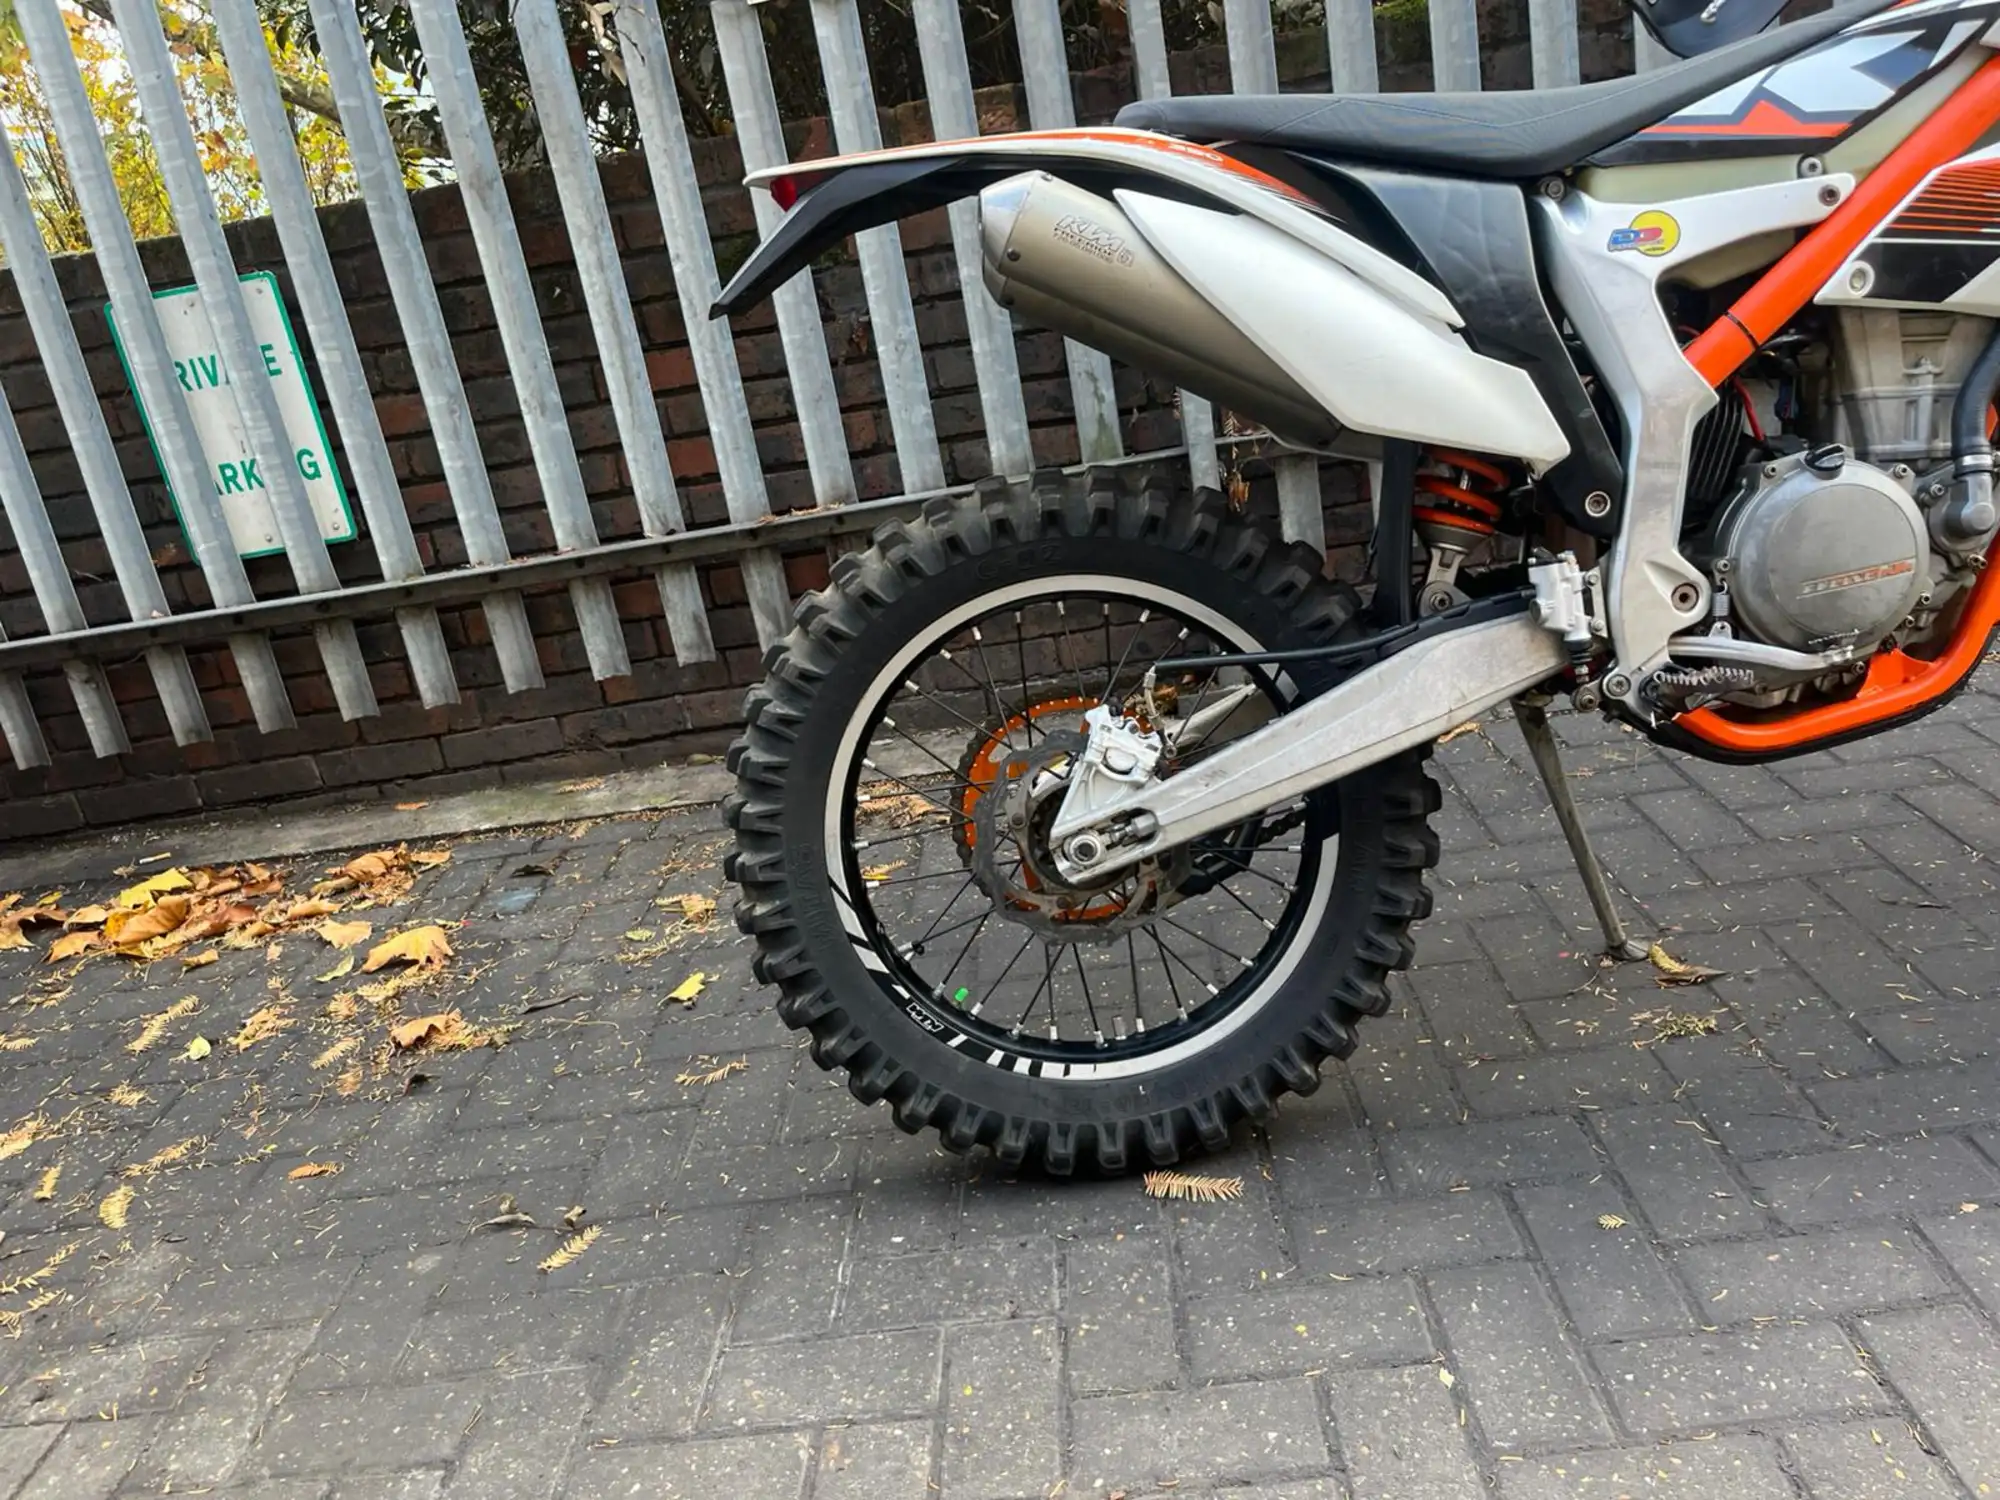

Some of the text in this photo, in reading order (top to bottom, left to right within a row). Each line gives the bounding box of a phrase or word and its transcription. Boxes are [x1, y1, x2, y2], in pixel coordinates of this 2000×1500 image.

[1055, 214, 1126, 253] KTM
[173, 343, 283, 392] RIVE
[905, 1001, 945, 1033] KTM
